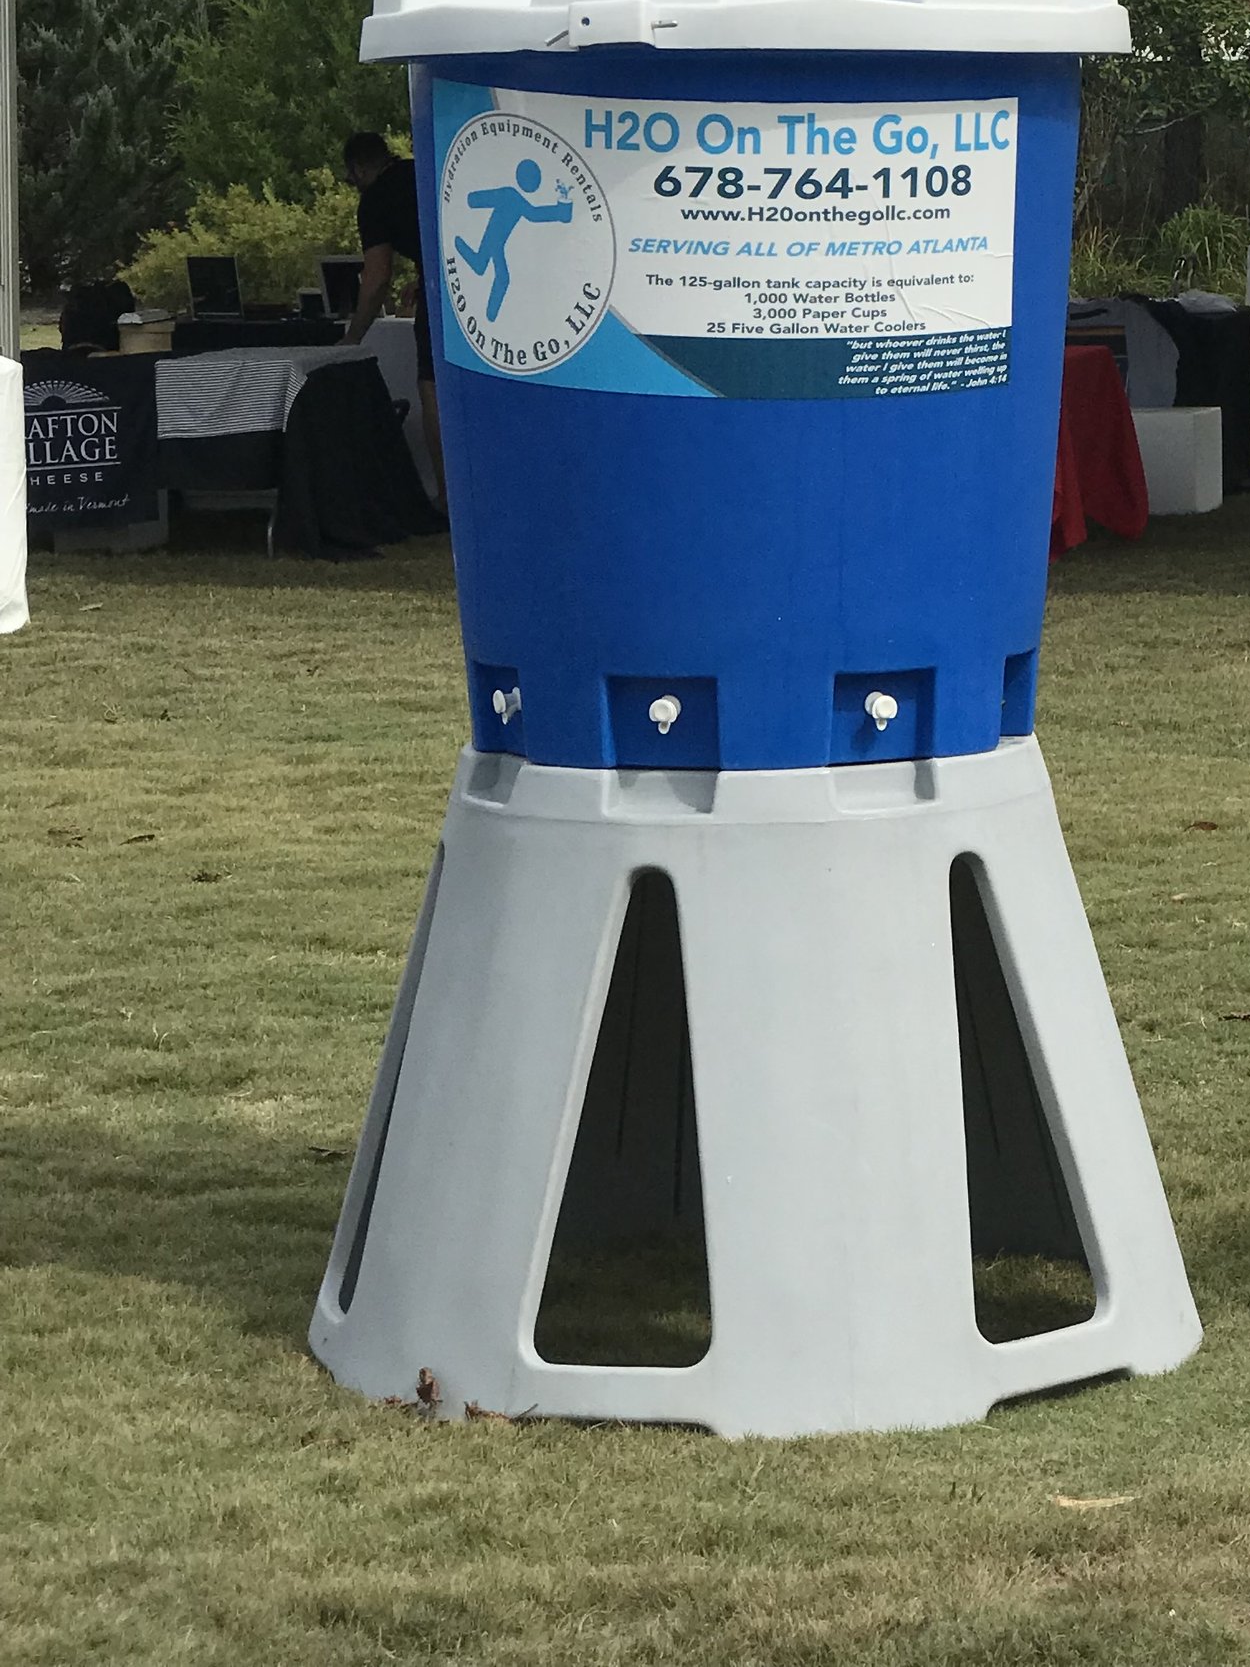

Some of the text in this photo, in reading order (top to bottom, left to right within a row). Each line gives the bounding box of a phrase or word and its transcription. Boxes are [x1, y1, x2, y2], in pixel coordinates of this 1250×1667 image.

[584, 109, 1010, 159] H2O On The Go, LLC
[443, 119, 603, 223] Hydration Equipment Rentals
[653, 164, 972, 200] 678-764-1108
[628, 236, 988, 257] SERVING ALL OF METRO ATLANTA
[646, 273, 975, 291] The 125-gallon tank capacity is equivalent to:
[744, 291, 896, 305] 1,000 Water Bottles
[446, 256, 601, 365] H2O On The Go, LLC
[752, 307, 887, 321] 3,000 Paper Cups
[706, 320, 926, 334] 25 Five Gallon Water Coolers
[875, 339, 925, 349] whoever
[925, 335, 957, 346] drinks
[959, 333, 975, 343] the
[976, 331, 1001, 341] water
[845, 363, 881, 373] water
[889, 361, 914, 373] give
[917, 359, 944, 369] them
[945, 357, 963, 367] will
[964, 354, 998, 365] become
[999, 352, 1008, 361] in
[852, 341, 1006, 363] give them will never thirst, the
[838, 364, 1008, 385] them a spring of water welling up
[875, 385, 889, 395] to
[890, 382, 930, 394] eternal
[966, 378, 988, 388] John
[988, 374, 1007, 384] 4:14
[25, 412, 117, 439] AFTON
[28, 436, 117, 465] LLAGE
[30, 472, 103, 485] HEESE
[28, 502, 58, 513] made
[77, 493, 130, 510] Vermont
